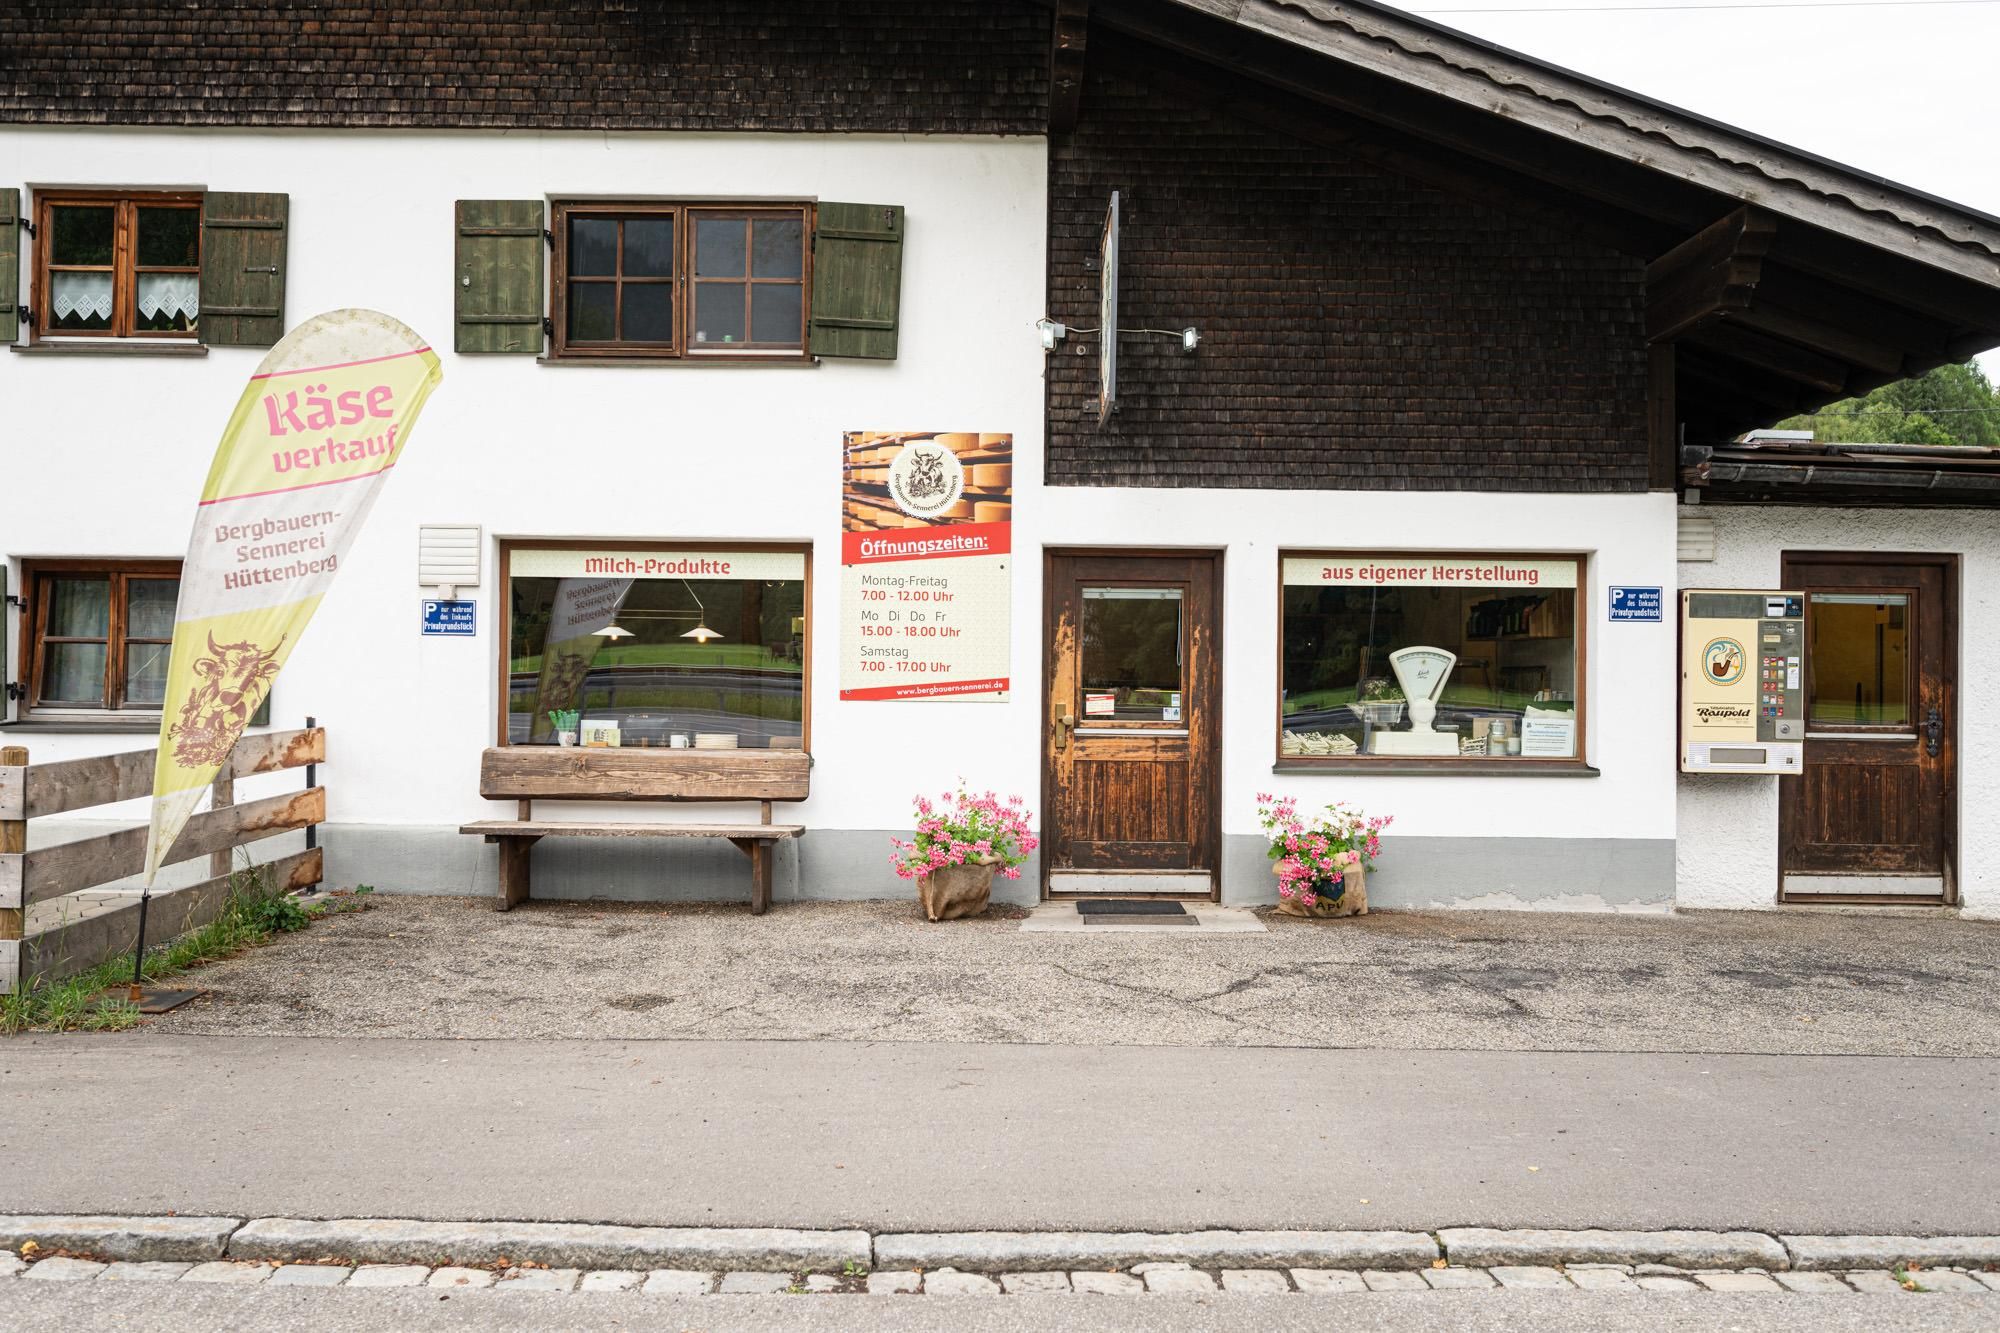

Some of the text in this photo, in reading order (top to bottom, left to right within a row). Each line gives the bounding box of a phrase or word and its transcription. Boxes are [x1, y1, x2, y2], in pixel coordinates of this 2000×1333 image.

[263, 383, 394, 436] Käse
[272, 424, 399, 474] verkauf
[215, 510, 342, 543] Bergbauern-
[236, 532, 326, 563] Sennerei
[860, 534, 988, 556] Öffnungszeiten:
[223, 554, 338, 590] Hüttenberg
[585, 557, 731, 576] Milch-Produkte
[1322, 564, 1539, 585] aus eigener Herstellung
[861, 575, 948, 589] Montag-Freitag
[861, 590, 886, 601] 7.00
[898, 591, 929, 601] 12.00
[933, 592, 954, 602] Uhr
[1612, 589, 1624, 605] P
[425, 602, 438, 618] P
[861, 610, 947, 622] Mo Di Do Fr
[860, 625, 893, 636] 15.00
[903, 626, 937, 637] 18.00
[940, 627, 961, 637] Uhr
[860, 646, 909, 659] Samstag
[860, 661, 885, 672] 7.00
[897, 661, 927, 672] 17.00
[930, 662, 951, 672] Uhr
[896, 681, 1003, 696] www.bergbauern-sennerei.de
